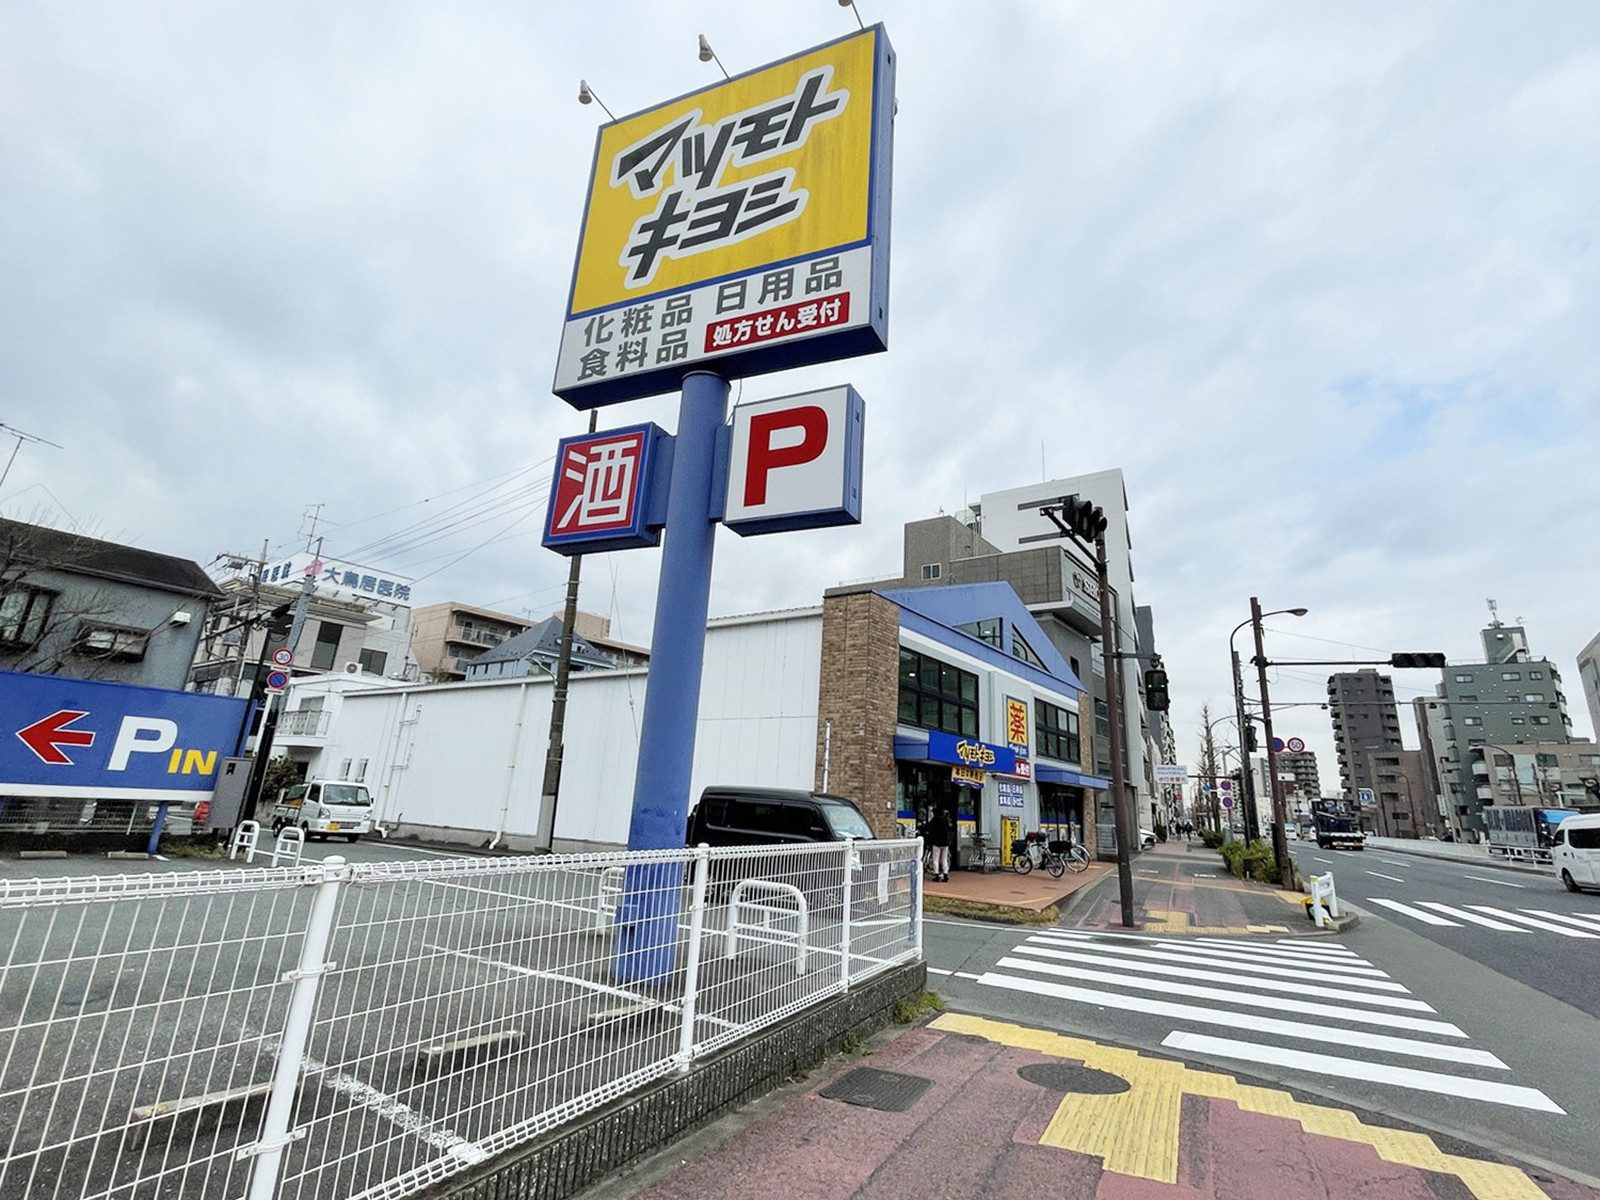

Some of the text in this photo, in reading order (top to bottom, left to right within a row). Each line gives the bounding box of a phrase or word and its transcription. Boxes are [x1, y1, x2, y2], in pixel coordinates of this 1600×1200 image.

[615, 70, 842, 193] マツモト
[626, 174, 801, 281] キヨシ
[715, 256, 843, 315] 日用品
[583, 294, 693, 347] 化粧品
[712, 298, 842, 348] 処方せん受付
[576, 329, 689, 382] 食料品
[743, 405, 829, 508] P
[557, 439, 638, 529] 酒
[322, 567, 412, 601] 大鳥居医院
[278, 653, 289, 661] 30
[107, 716, 178, 771] P
[1010, 702, 1025, 743] 薬
[1291, 741, 1301, 749] 50
[167, 749, 217, 775] IN
